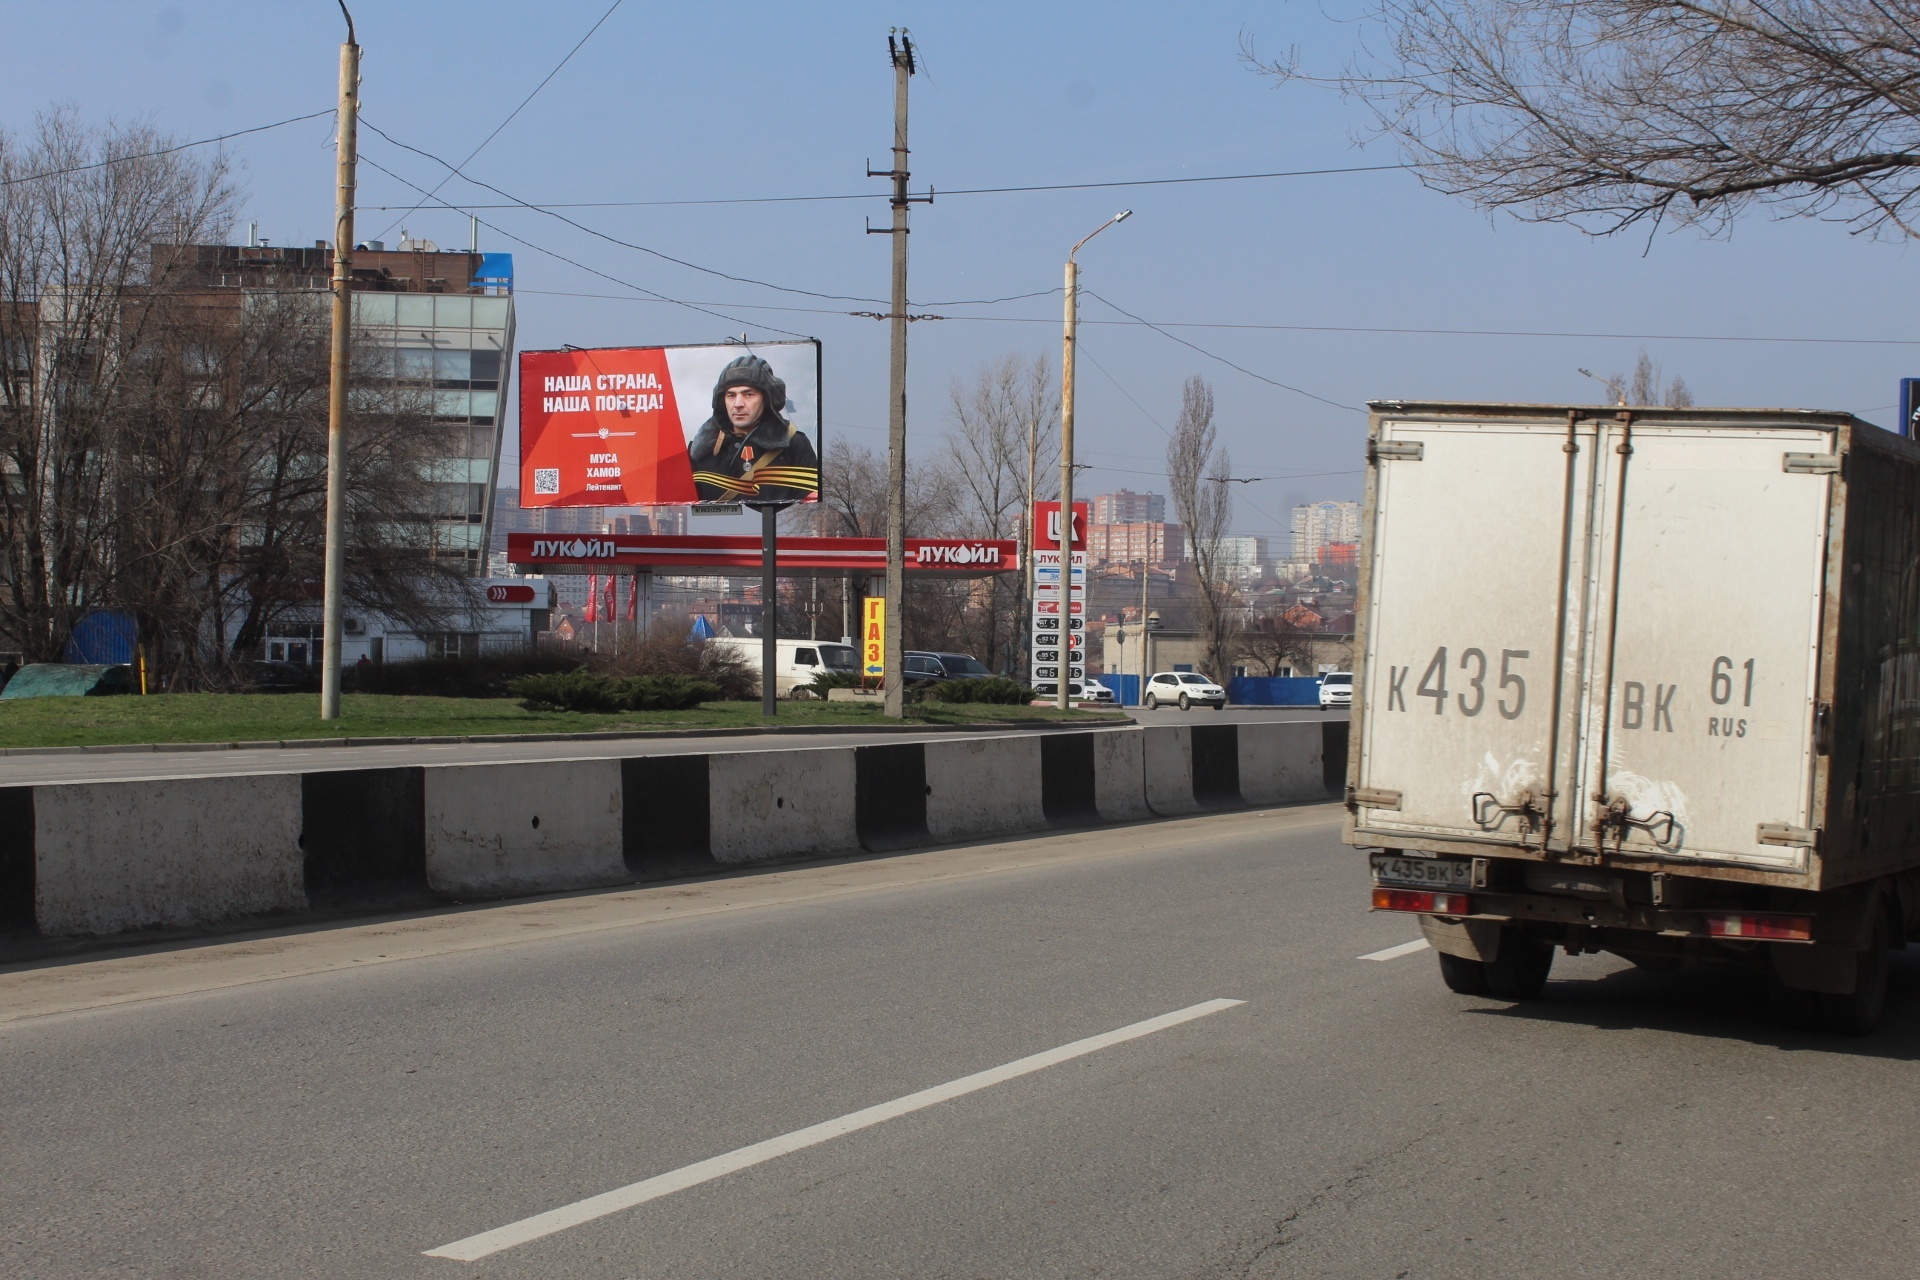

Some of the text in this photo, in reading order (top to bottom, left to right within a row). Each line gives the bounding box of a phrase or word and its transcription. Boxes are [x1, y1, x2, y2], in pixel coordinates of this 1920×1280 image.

[544, 373, 662, 392] НАША СТРАНА,
[543, 394, 664, 413] НАША ПОБЕДА!
[590, 453, 618, 464] МУСА
[586, 467, 621, 478] ХАМОВ
[586, 483, 622, 491] Лейтенант
[868, 601, 881, 662] ГАЗ
[1710, 656, 1755, 708] 61
[1708, 716, 1748, 739] RUS
